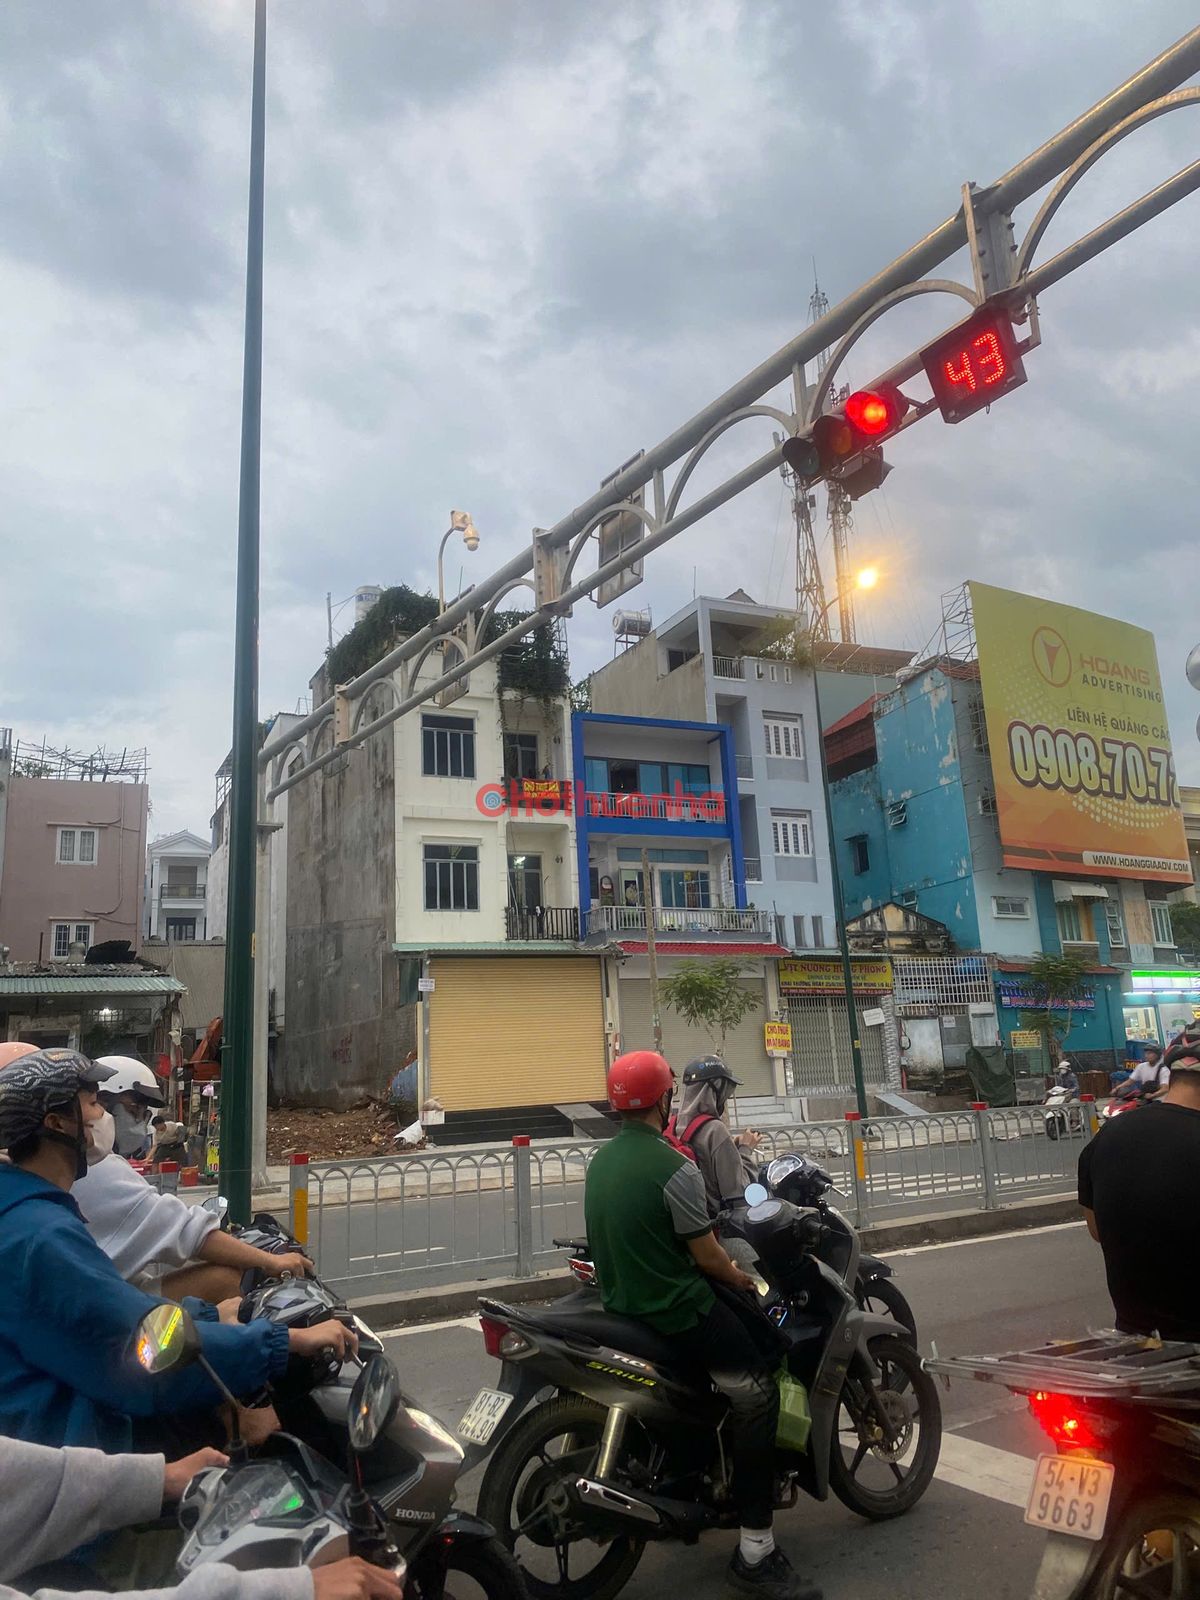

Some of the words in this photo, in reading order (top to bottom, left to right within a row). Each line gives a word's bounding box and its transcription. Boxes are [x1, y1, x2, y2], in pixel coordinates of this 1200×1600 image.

[943, 332, 1005, 390] 43
[1082, 673, 1162, 703] ADVERTISING
[1067, 706, 1091, 724] LIÊN
[1093, 712, 1108, 731] HỆ
[1110, 717, 1149, 736] QUẢNG
[1092, 854, 1189, 872] WWW.HOANGGIAADV.COM
[586, 1361, 657, 1386] SIRIUS
[395, 1508, 436, 1521] HONDA
[1037, 1492, 1095, 1531] 9663
